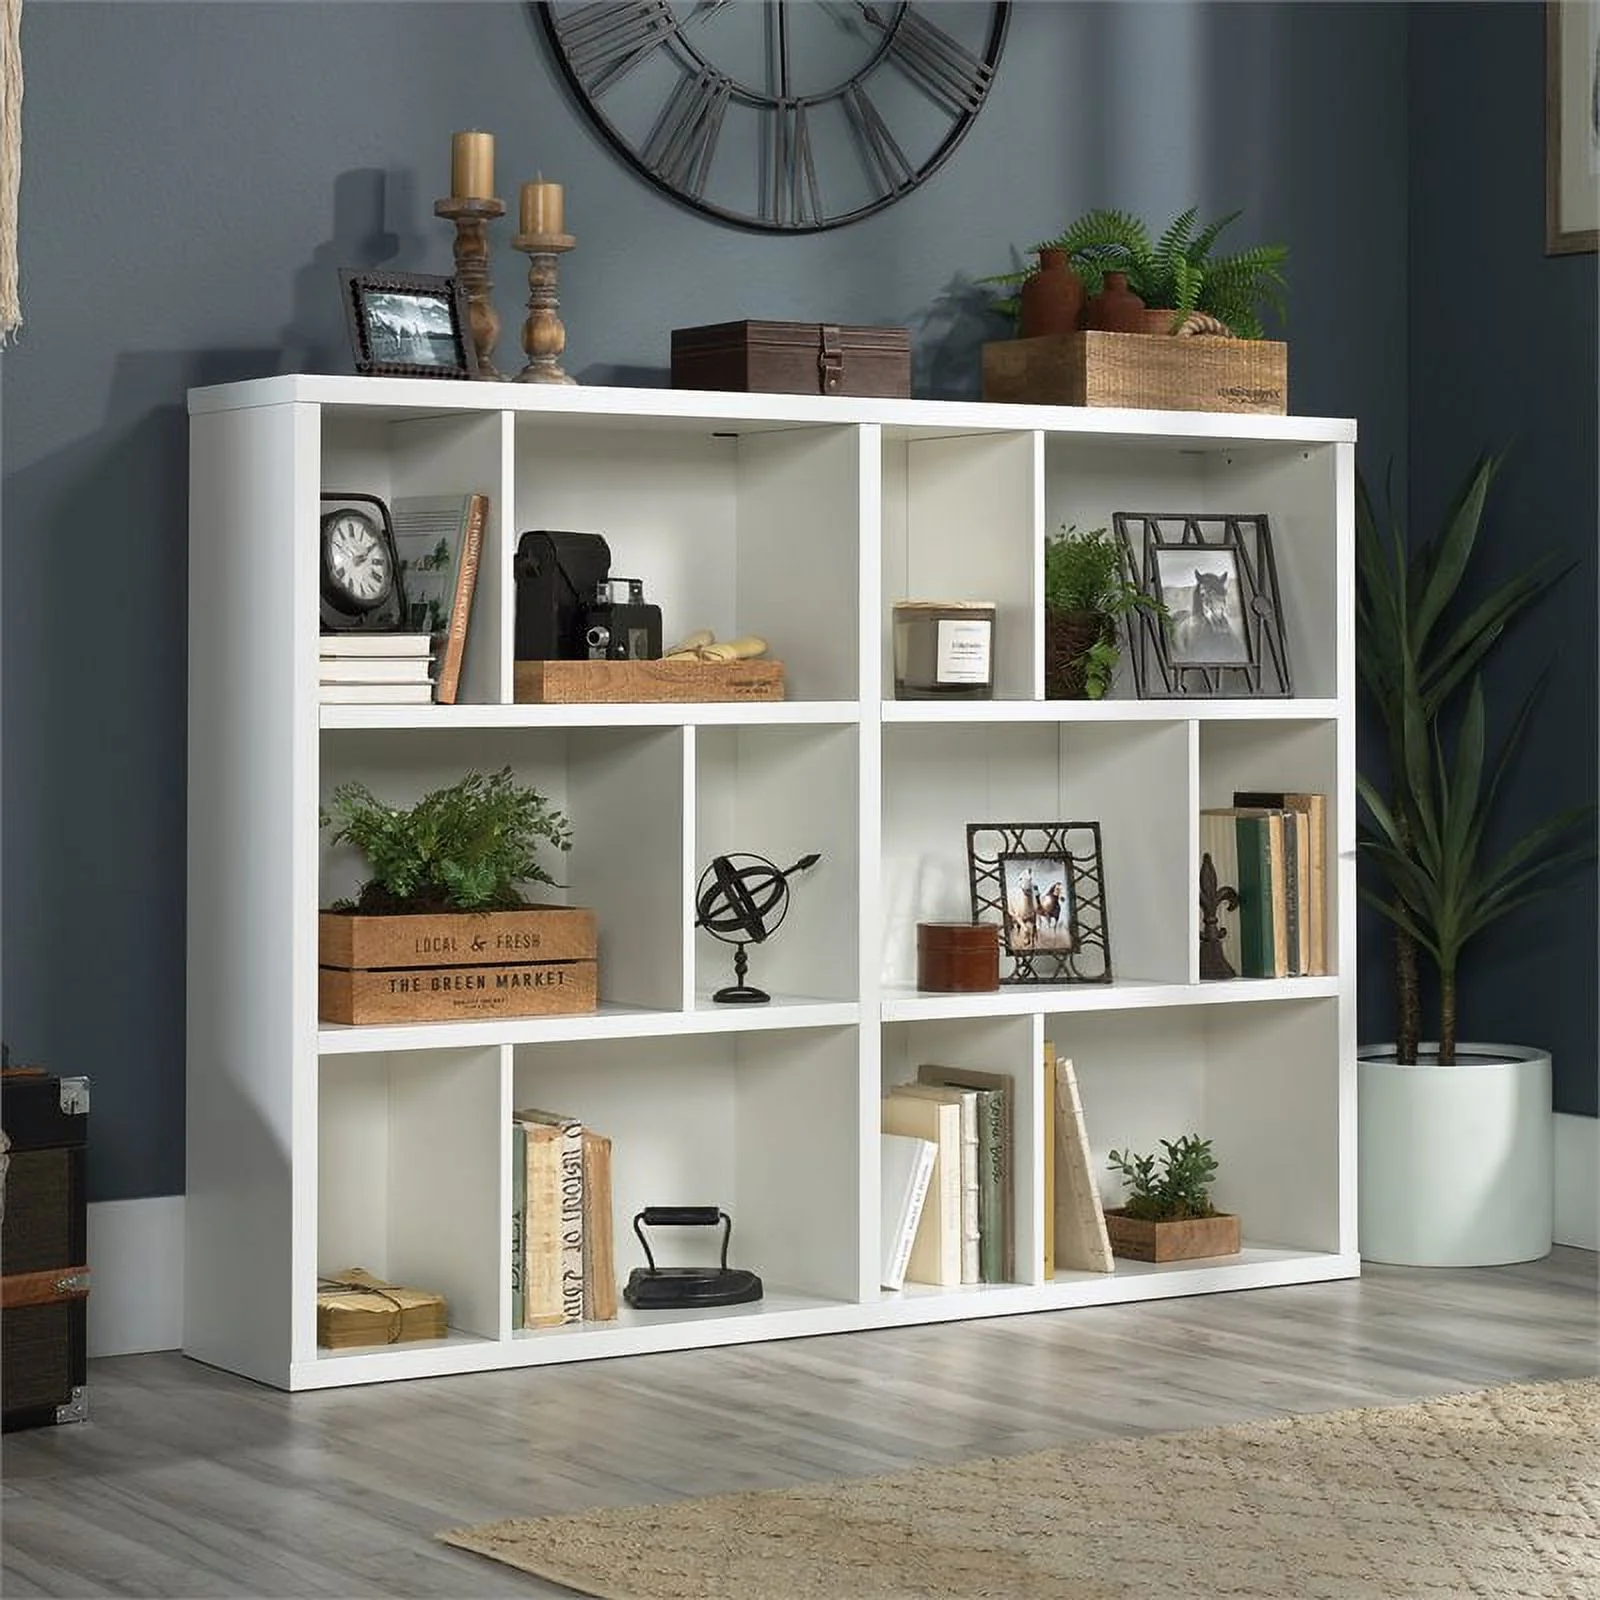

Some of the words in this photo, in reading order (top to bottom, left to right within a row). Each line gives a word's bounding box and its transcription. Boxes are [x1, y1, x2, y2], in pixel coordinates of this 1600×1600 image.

[415, 936, 458, 953] LOCAL
[470, 934, 487, 952] &
[496, 933, 542, 951] FRESH
[388, 976, 421, 993] THE
[431, 973, 486, 992] GREEN
[496, 970, 565, 989] MARKET
